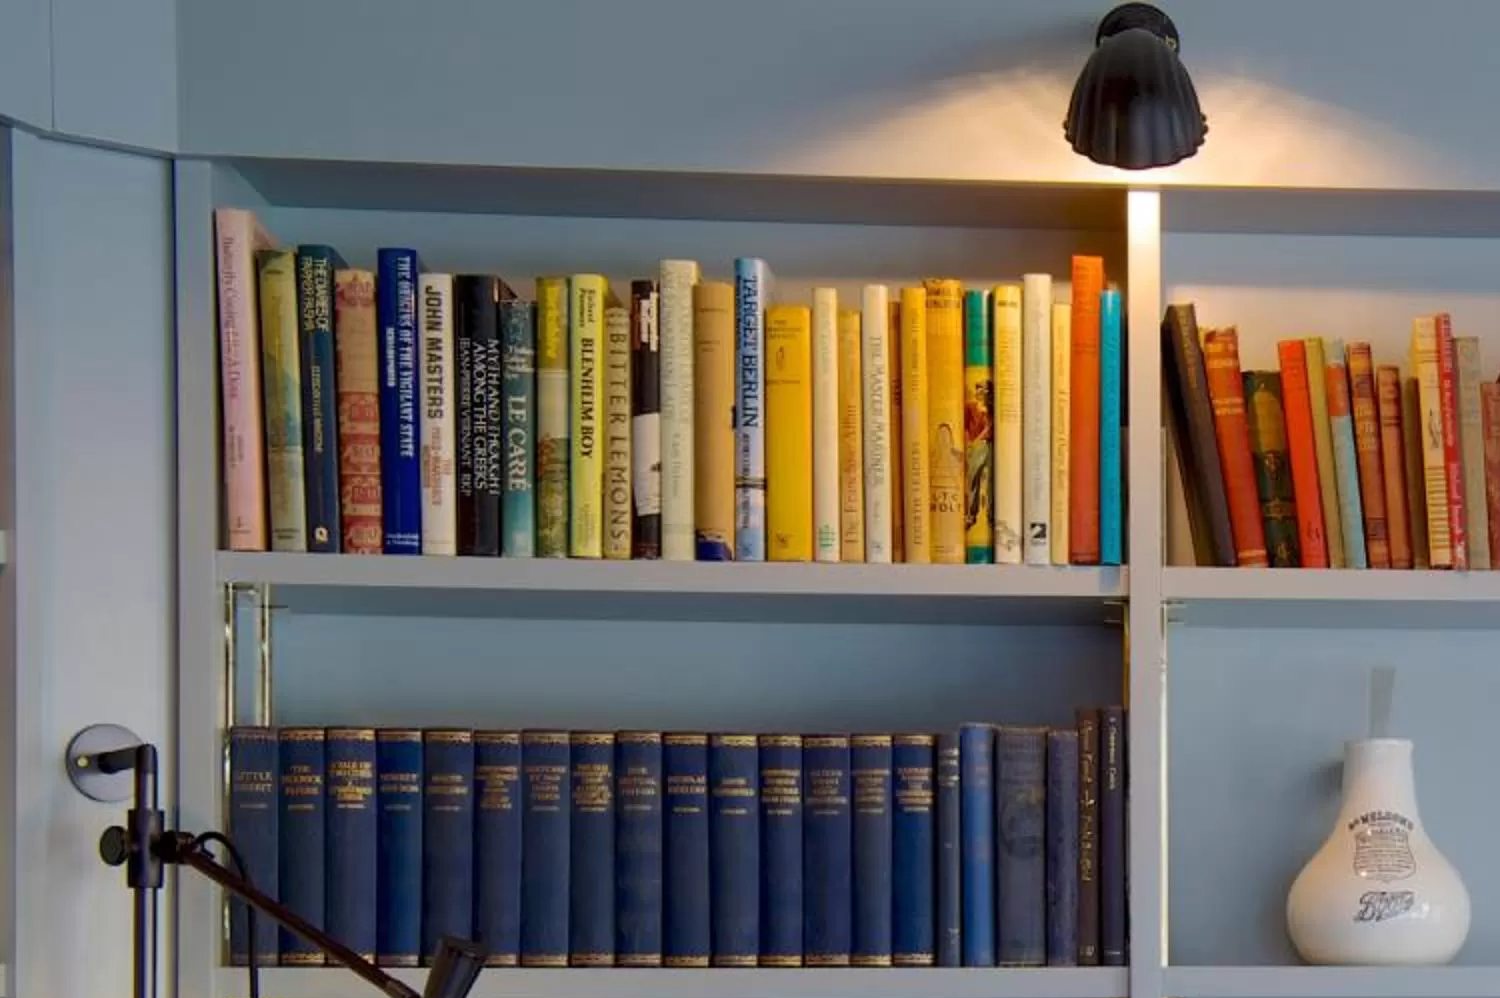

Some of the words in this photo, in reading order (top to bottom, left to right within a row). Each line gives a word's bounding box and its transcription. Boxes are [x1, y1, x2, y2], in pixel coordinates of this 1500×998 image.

[426, 286, 444, 331] JOHN
[742, 276, 758, 352] TARGET
[426, 337, 444, 419] MASTERS
[474, 342, 487, 402] AMONG
[581, 338, 595, 422] BLENHEIM
[610, 335, 628, 426] BITTER
[742, 355, 759, 428] BERLIN
[474, 405, 487, 434] THE
[509, 395, 527, 422] LE
[474, 436, 487, 490] GREEKS
[509, 428, 530, 493] CARRÉ
[580, 425, 594, 459] BOY
[610, 437, 628, 543] LEMONS
